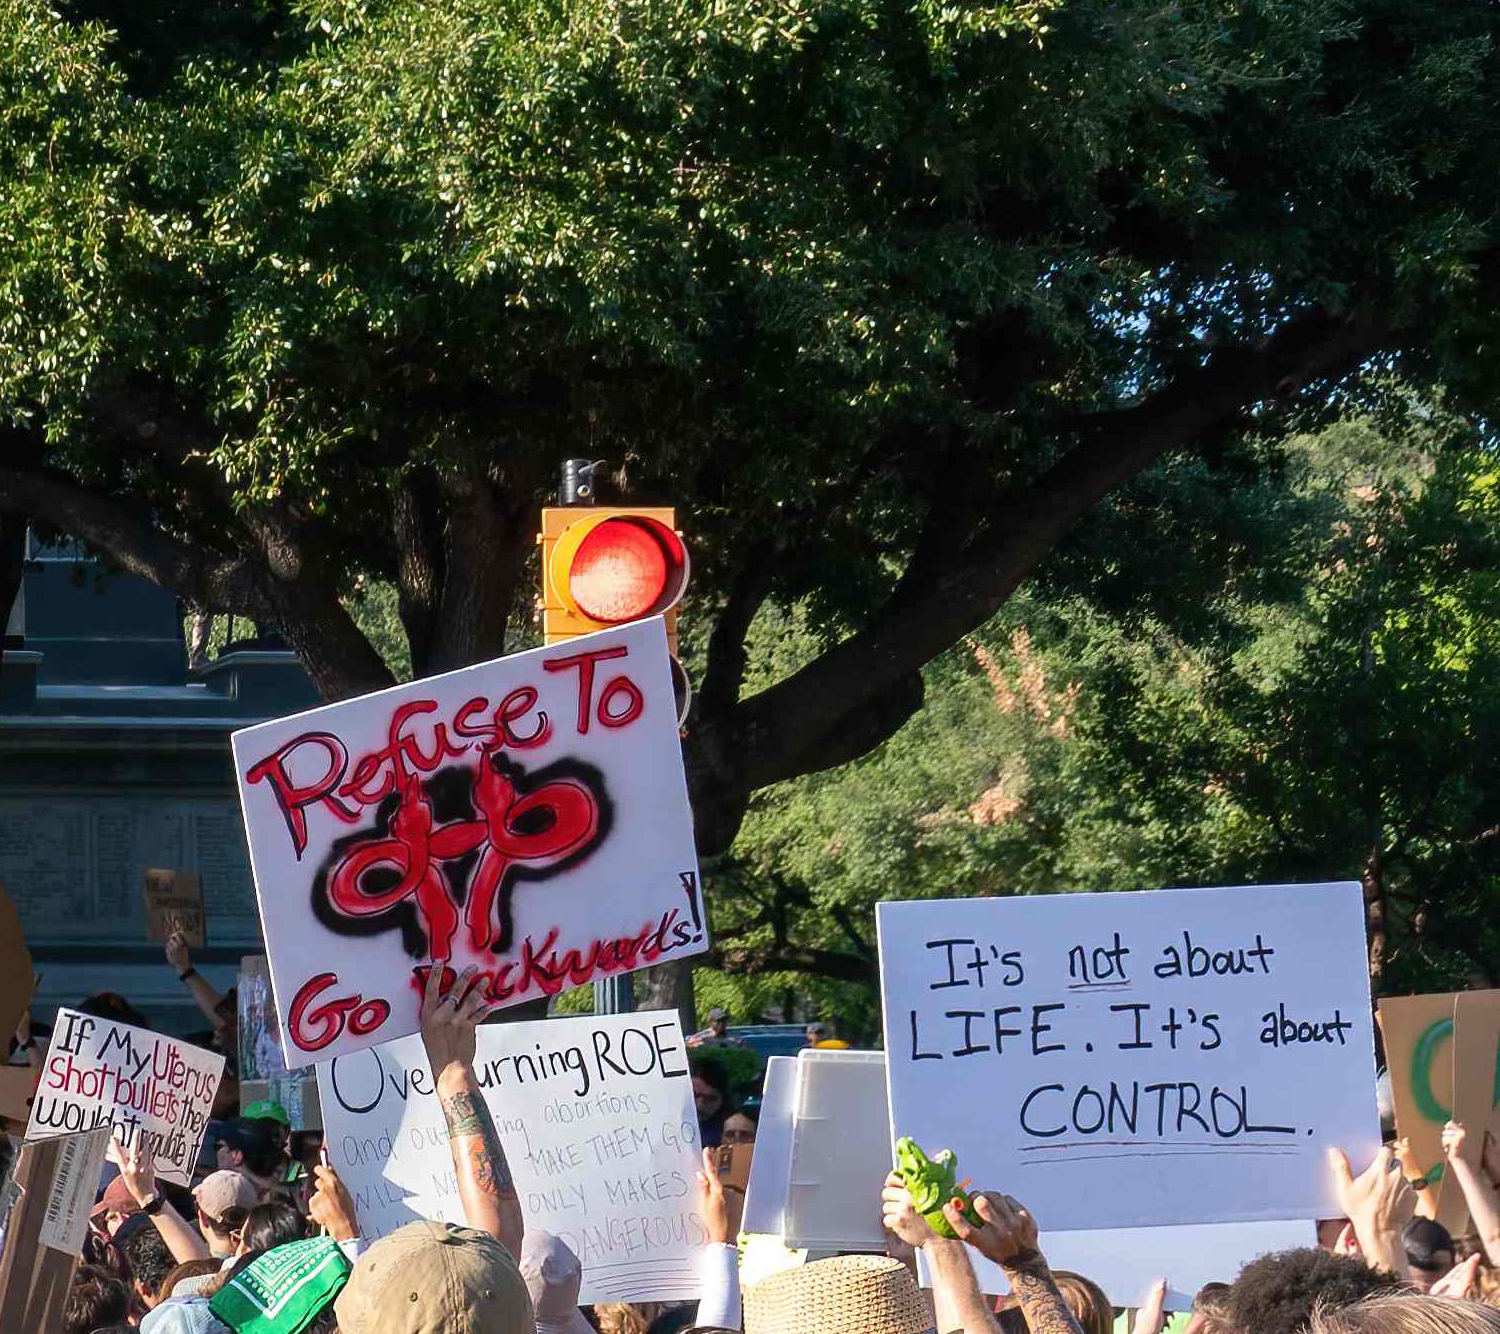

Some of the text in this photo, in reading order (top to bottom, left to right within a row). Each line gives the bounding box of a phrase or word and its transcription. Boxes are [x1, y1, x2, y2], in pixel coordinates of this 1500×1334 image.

[246, 646, 644, 860] Refuse To
[926, 931, 1274, 991] It's not about
[288, 972, 391, 1052] Go
[909, 1002, 1352, 1061] LIFE. It's about
[55, 1013, 216, 1103] If My Uterus
[332, 1022, 687, 1113] Oveurning ROE
[114, 1077, 180, 1126] bullets
[180, 1098, 210, 1137] they
[544, 1092, 652, 1126] abortions
[1020, 1082, 1315, 1139] CONTROL.
[524, 1122, 697, 1176] MAKE THEM GO
[528, 1171, 689, 1214] ONLY MAKES
